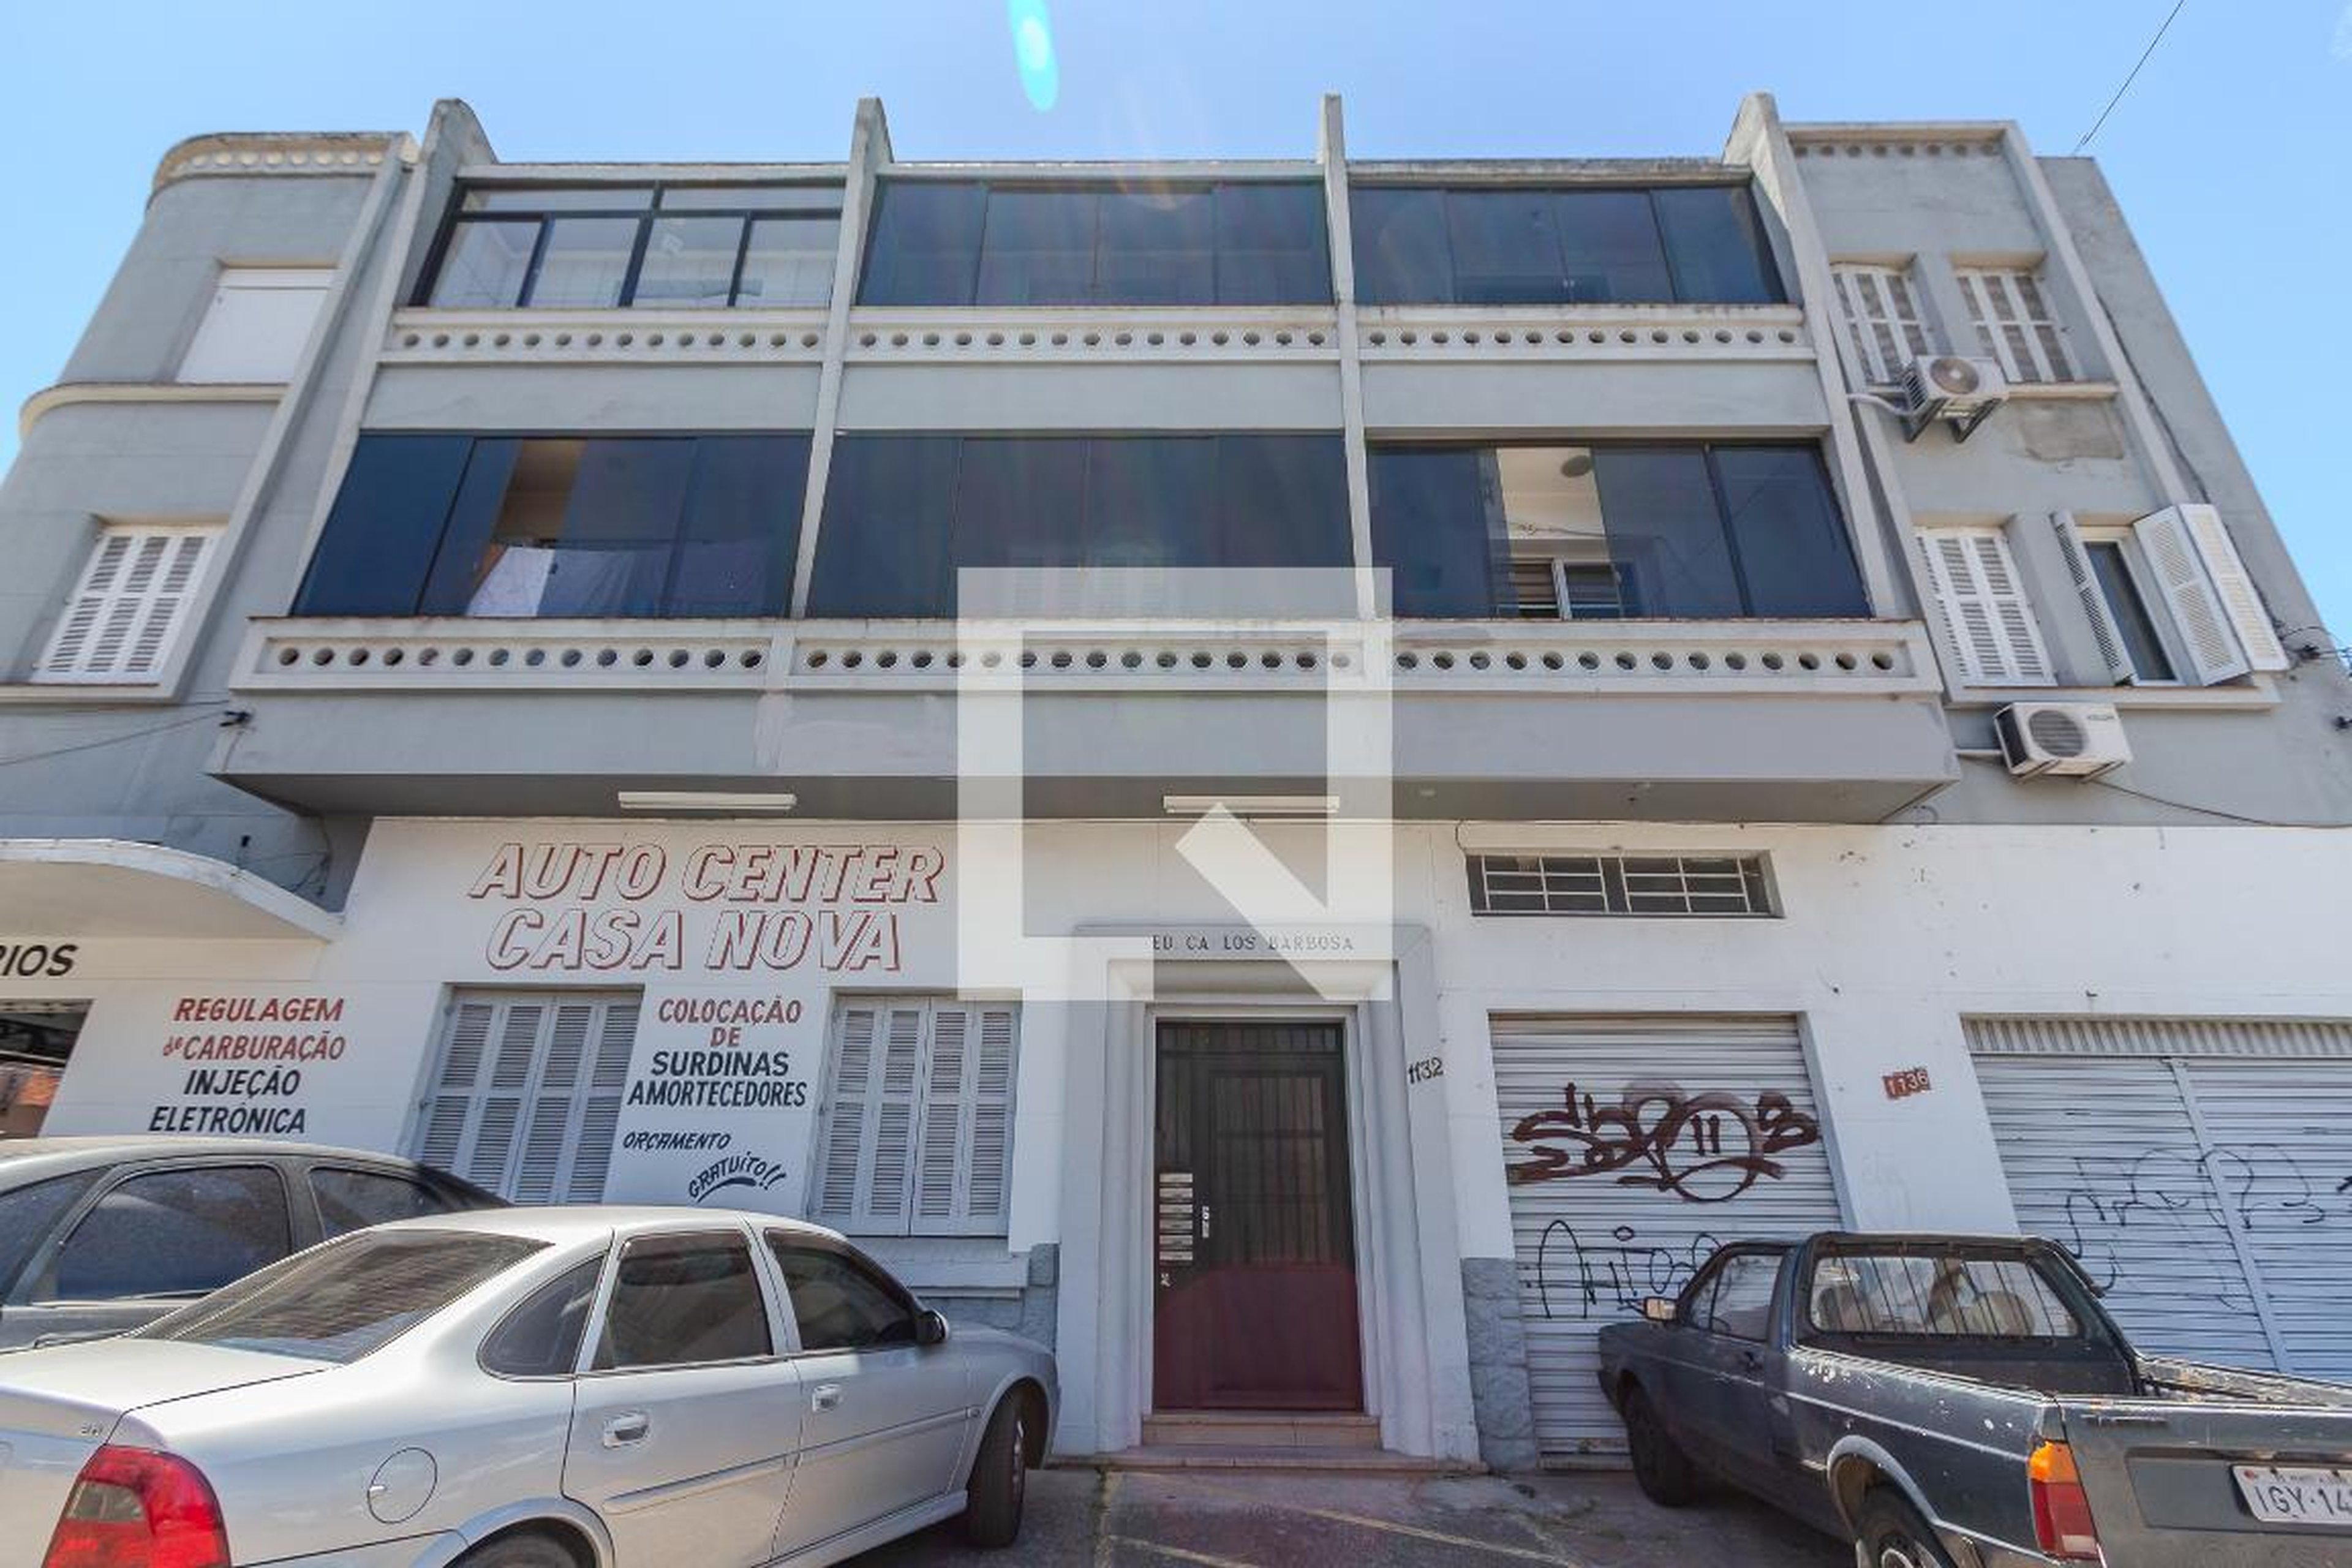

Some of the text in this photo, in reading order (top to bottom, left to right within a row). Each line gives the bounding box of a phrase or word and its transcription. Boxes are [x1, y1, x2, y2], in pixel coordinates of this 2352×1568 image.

[467, 843, 944, 902] AUTO CENTER
[486, 908, 900, 971] CASA NOVA
[173, 998, 344, 1022] REGULAGEM
[658, 995, 802, 1025] COLOCAÇÃO
[183, 1031, 346, 1061] CARBURAÇÃO
[710, 1027, 742, 1047] DE
[650, 1051, 789, 1076] SURDINAS
[1409, 1057, 1444, 1084] 1132
[183, 1065, 301, 1099] INJEÇÃO
[627, 1080, 807, 1107] AMORTECEDORES
[623, 1131, 731, 1152] ORÇAMENTO
